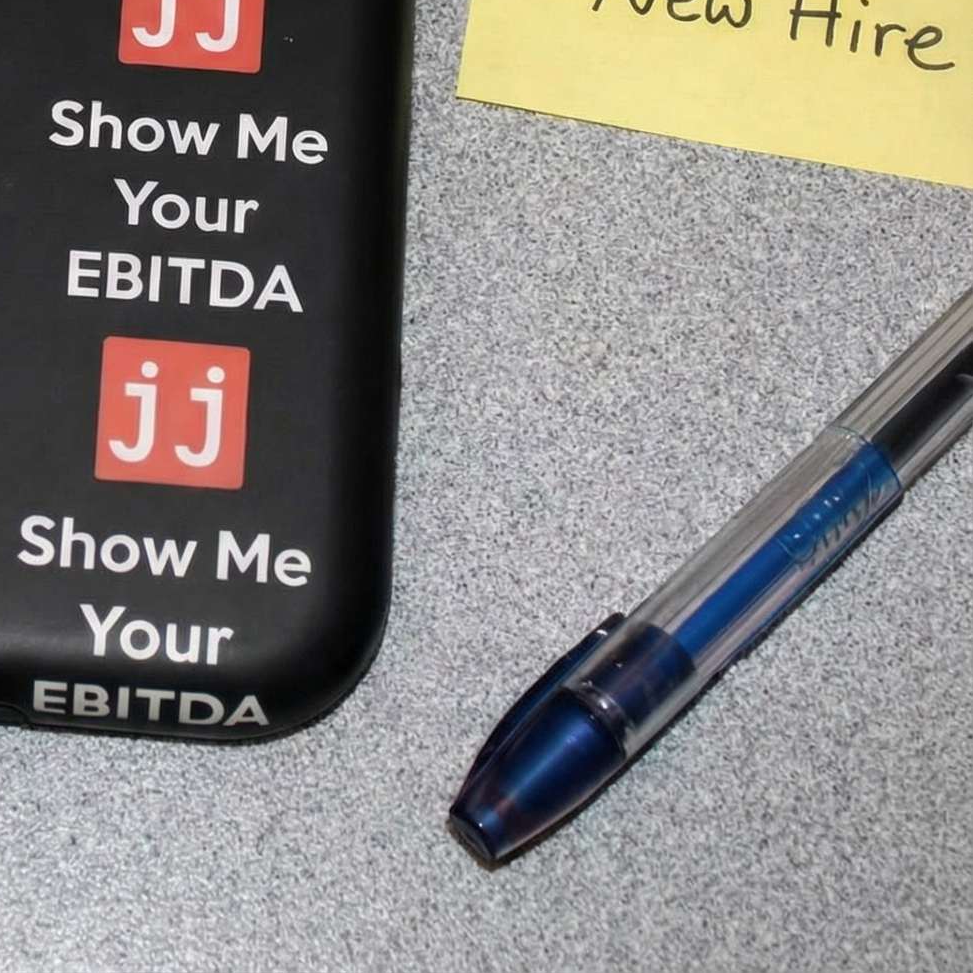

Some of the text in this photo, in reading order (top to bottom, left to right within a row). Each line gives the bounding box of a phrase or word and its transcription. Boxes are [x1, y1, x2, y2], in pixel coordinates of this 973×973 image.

[48, 99, 329, 165] Show Me
[113, 178, 260, 234] Your
[67, 249, 304, 313] EBITDA
[16, 514, 312, 587] Show Me
[79, 603, 235, 666] Your
[33, 680, 268, 725] EBITDA
